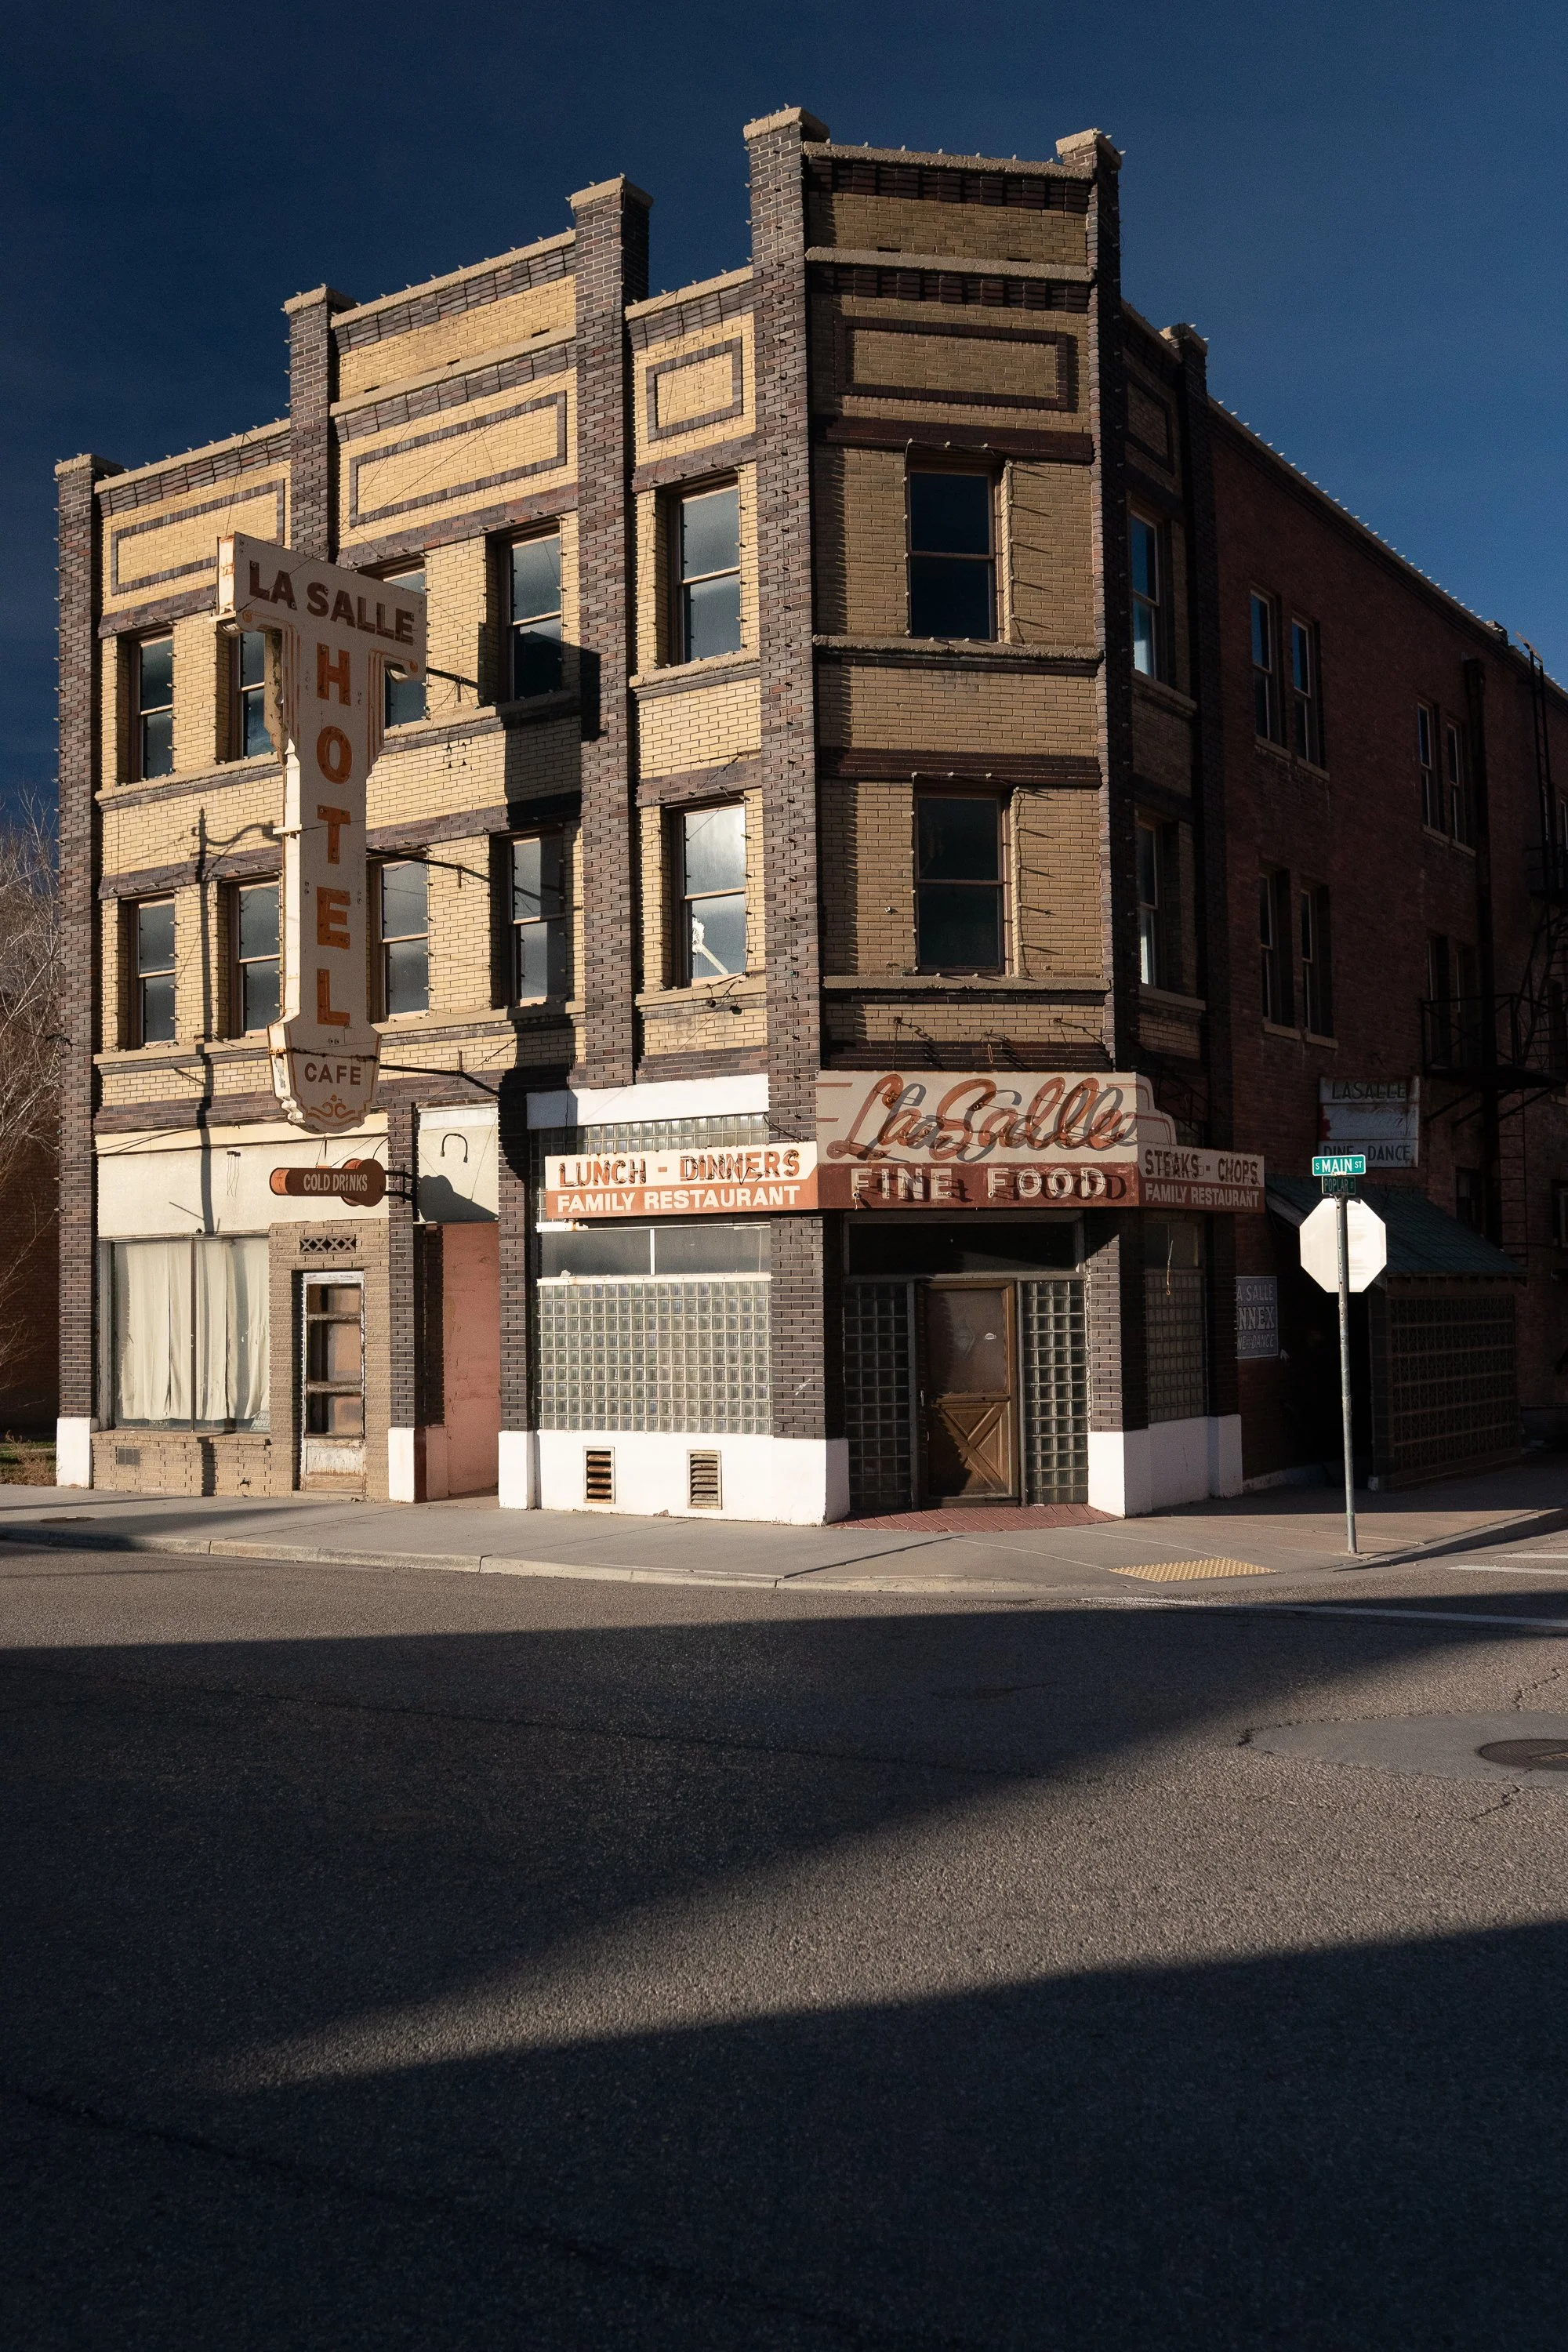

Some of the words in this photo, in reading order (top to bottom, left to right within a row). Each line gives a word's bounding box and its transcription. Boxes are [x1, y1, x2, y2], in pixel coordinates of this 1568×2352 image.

[249, 560, 297, 611] LA
[307, 582, 415, 646] SALLE
[316, 642, 353, 1026] HOTEL
[304, 1062, 361, 1086] CAFE
[1331, 1081, 1406, 1099] LASALLE
[1315, 1162, 1320, 1171] S
[1321, 1158, 1352, 1173] MAIN
[1354, 1160, 1363, 1169] ST
[1367, 1145, 1410, 1161] DANCE
[557, 1158, 646, 1187] LUNCH
[680, 1149, 800, 1181] DINNERS
[1145, 1149, 1200, 1180] STEAKS
[1218, 1157, 1259, 1184] CHOPS
[303, 1174, 331, 1192] COLD
[332, 1174, 368, 1192] DRINKS
[851, 1167, 952, 1200] FINE
[988, 1167, 1106, 1199] FOOD
[1145, 1182, 1188, 1203] FAMILY
[1191, 1186, 1260, 1207] RESTAURANT
[1323, 1178, 1348, 1192] POPLAR
[557, 1192, 636, 1213] FAMILY
[644, 1185, 800, 1209] RESTAURANT
[1236, 1284, 1243, 1301] A
[1246, 1283, 1274, 1301] SALLE
[1236, 1305, 1275, 1330] NNEX
